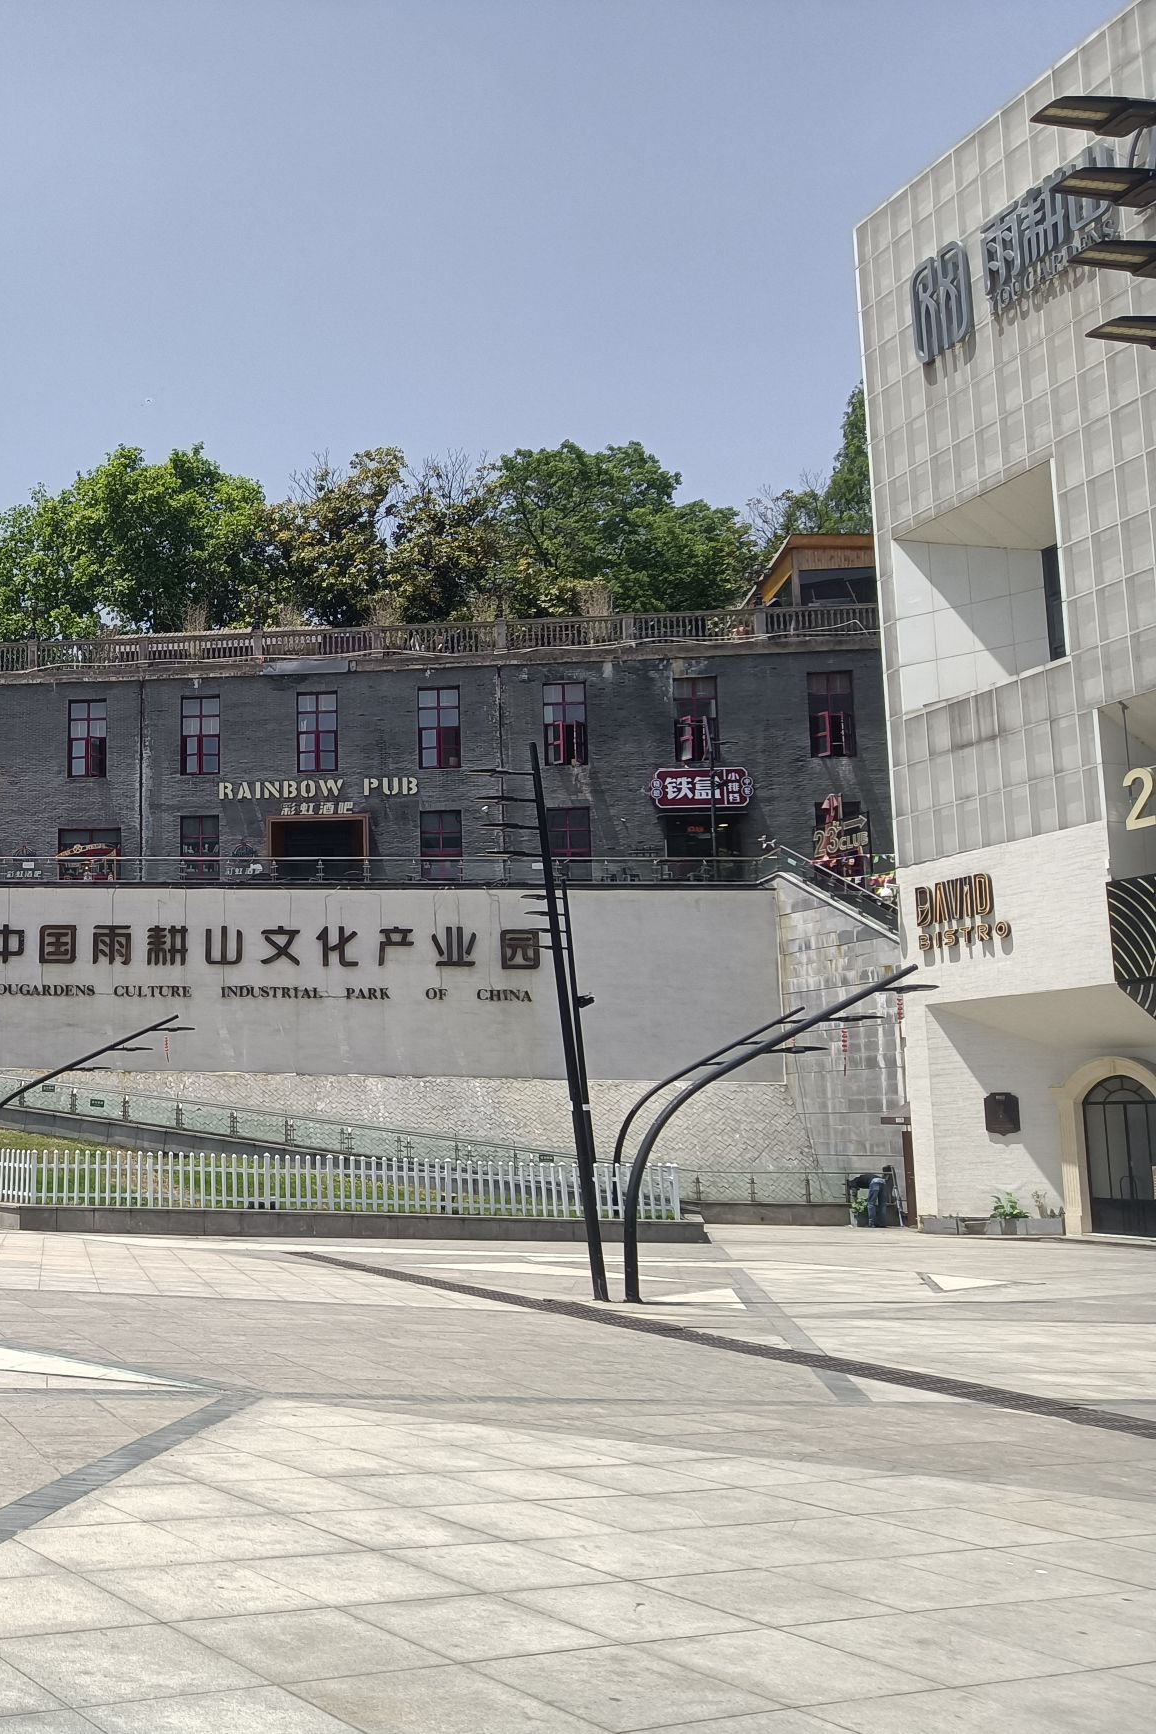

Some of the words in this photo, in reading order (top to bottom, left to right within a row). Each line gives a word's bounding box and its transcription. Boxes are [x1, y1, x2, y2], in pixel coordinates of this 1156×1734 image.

[218, 779, 344, 800] RAINBOW
[363, 777, 419, 796] PUB
[664, 776, 722, 800] 铁盒
[727, 772, 740, 803] 小排档
[280, 801, 354, 816] 彩虹酒吧
[914, 872, 995, 928] DAVID
[918, 920, 1012, 951] BISTRO
[113, 984, 193, 999] CULTURE
[220, 985, 324, 1000] INDUSTRIAL
[345, 987, 392, 1001] PARK
[425, 987, 449, 1001] OF
[476, 987, 533, 1003] CHINA
